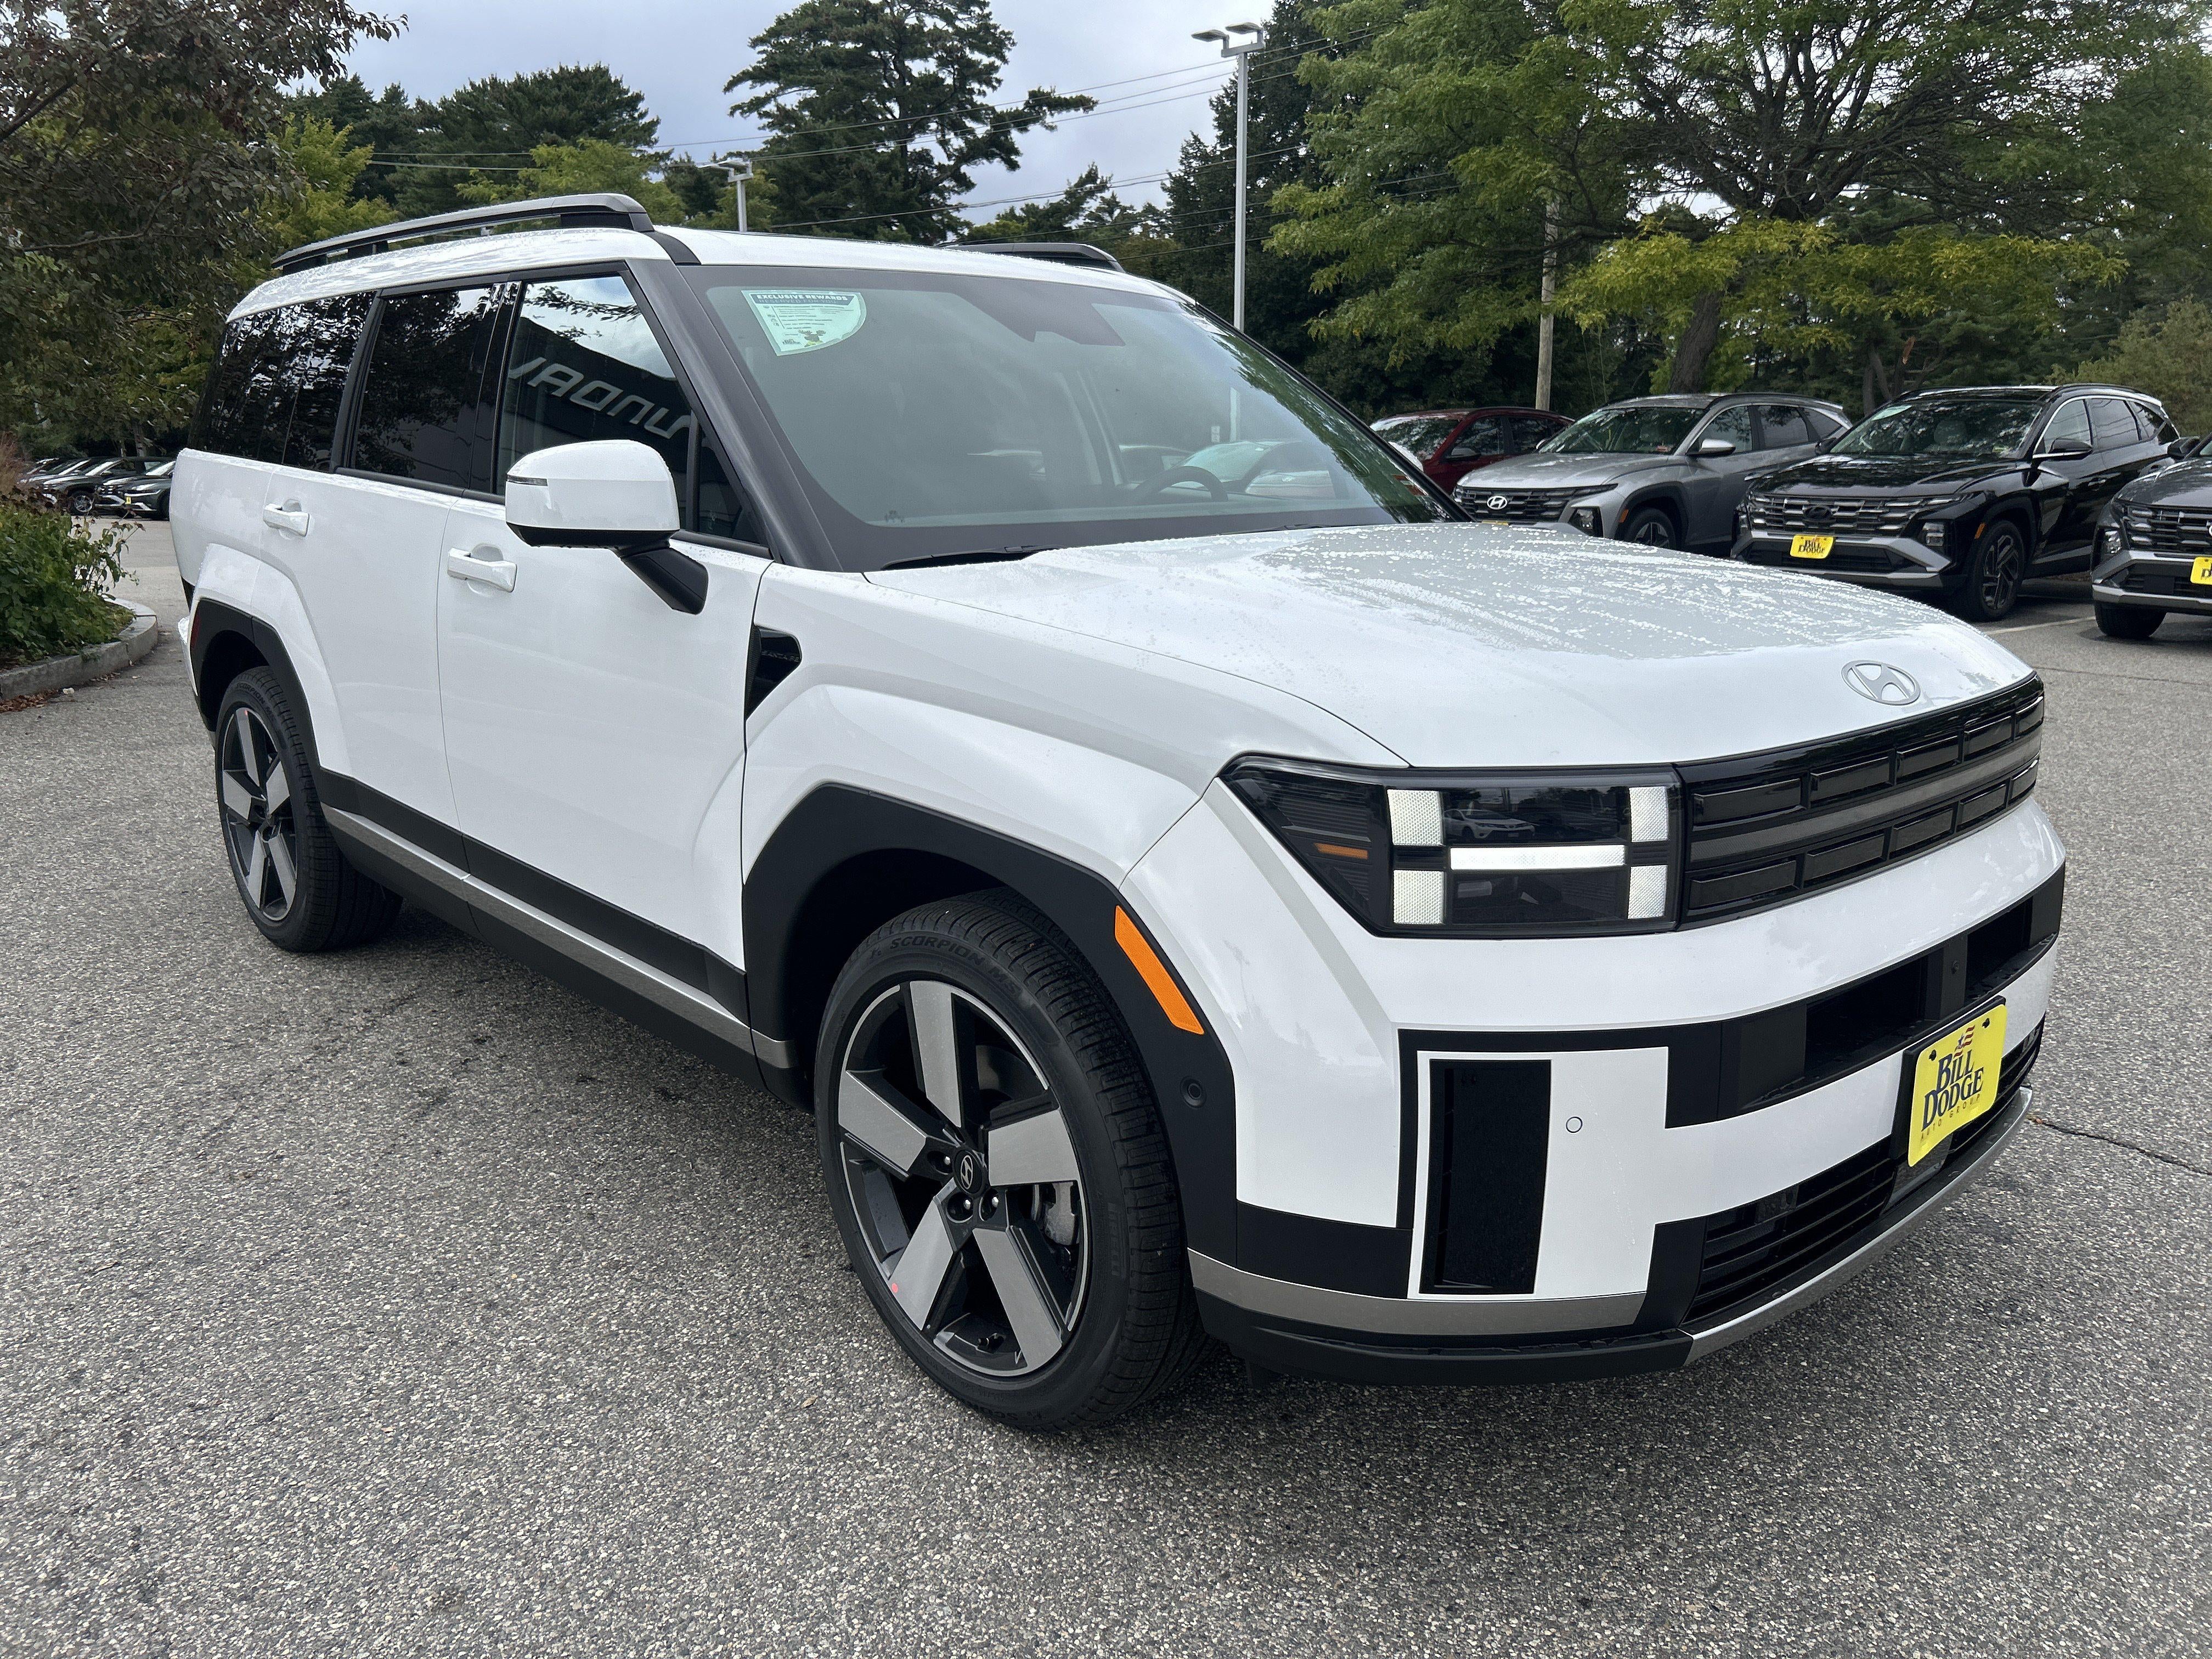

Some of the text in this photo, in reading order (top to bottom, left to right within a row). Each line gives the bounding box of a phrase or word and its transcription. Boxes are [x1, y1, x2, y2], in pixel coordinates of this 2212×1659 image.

[890, 935, 985, 966] SCORPION
[1936, 1048, 1974, 1093] BILL
[1920, 1093, 1980, 1142] AUTO GROUP
[1921, 1066, 1984, 1132] DODGE
